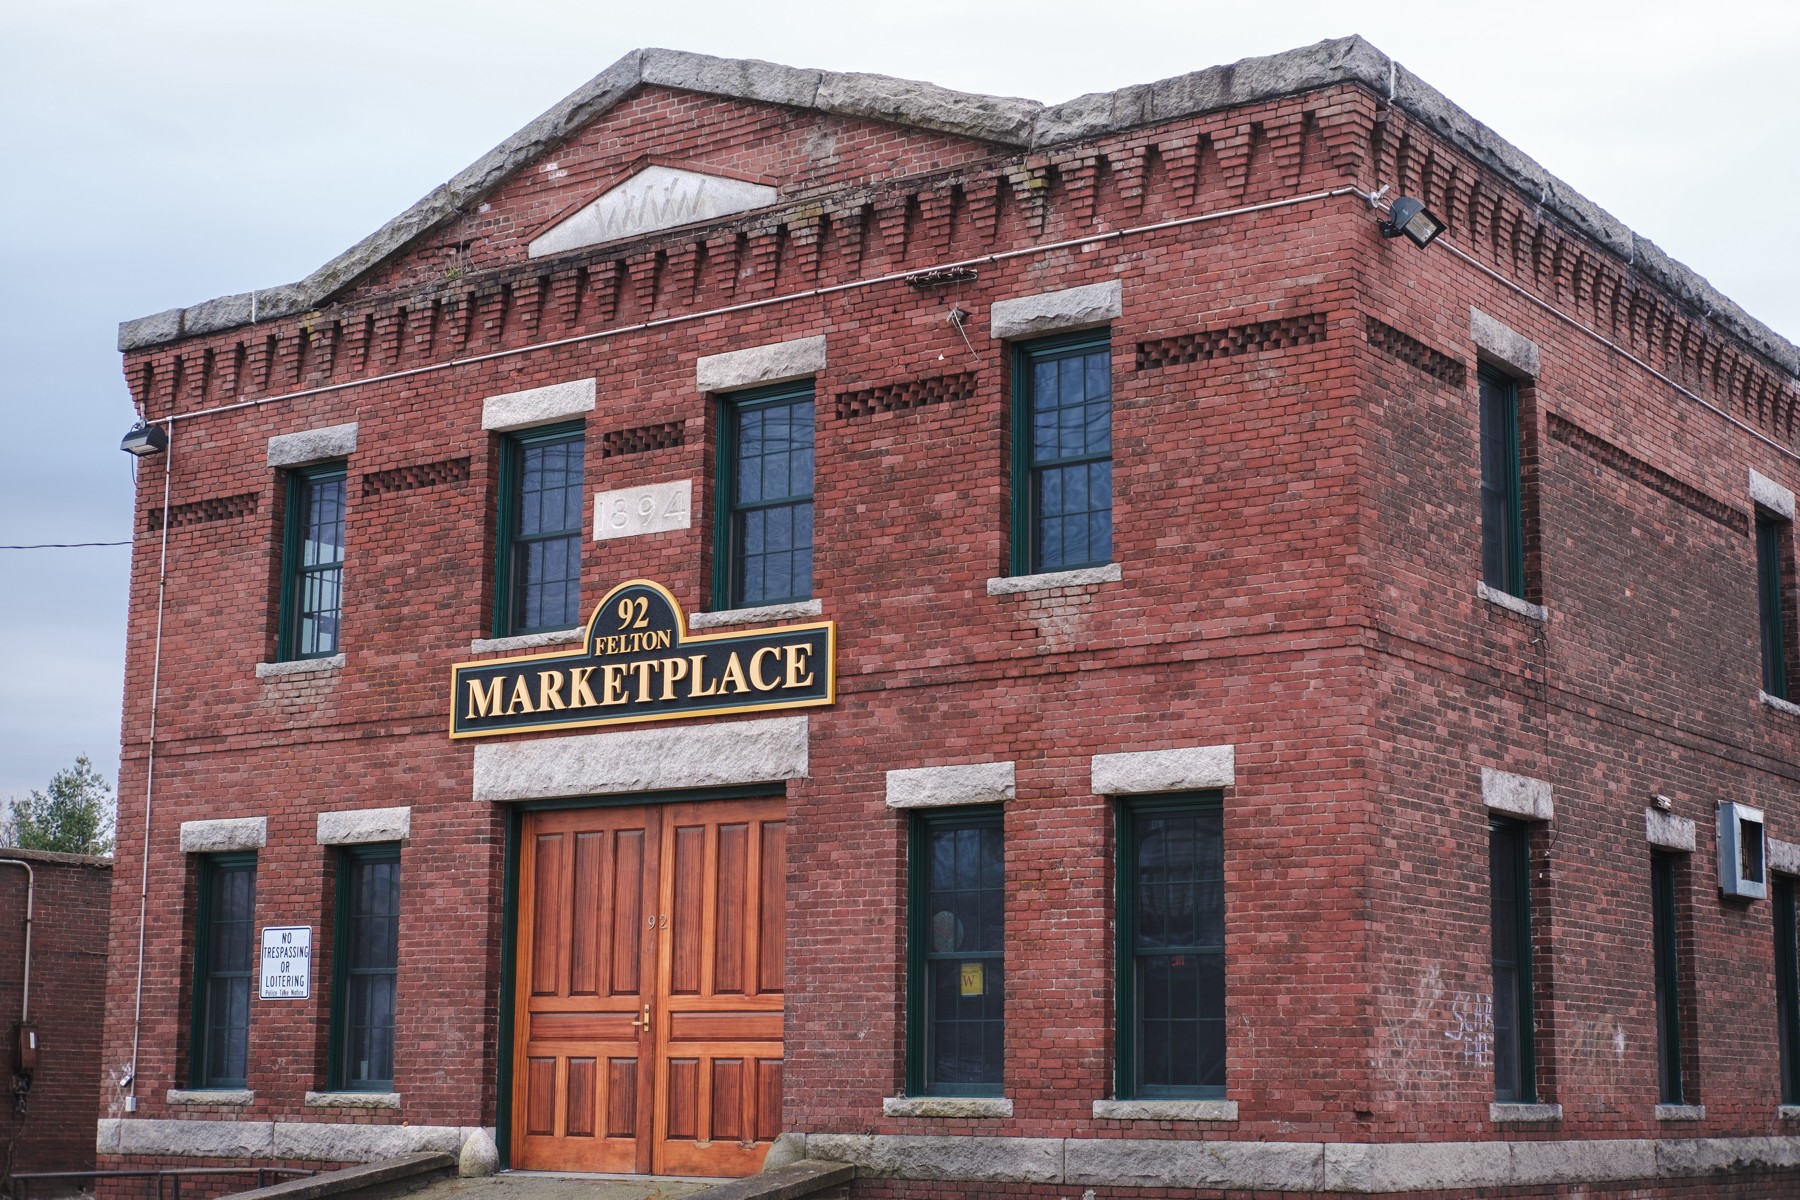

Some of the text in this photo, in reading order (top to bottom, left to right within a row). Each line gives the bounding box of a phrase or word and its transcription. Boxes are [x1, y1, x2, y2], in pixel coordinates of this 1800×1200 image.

[597, 490, 686, 531] 1894
[618, 597, 649, 630] 92
[594, 629, 672, 656] FELTON
[465, 643, 814, 719] MARKETPLACE
[648, 915, 667, 930] 92
[282, 932, 292, 944] NO
[264, 946, 308, 958] TRESPASSING
[280, 961, 290, 973] OR
[265, 975, 305, 987] LOITERING
